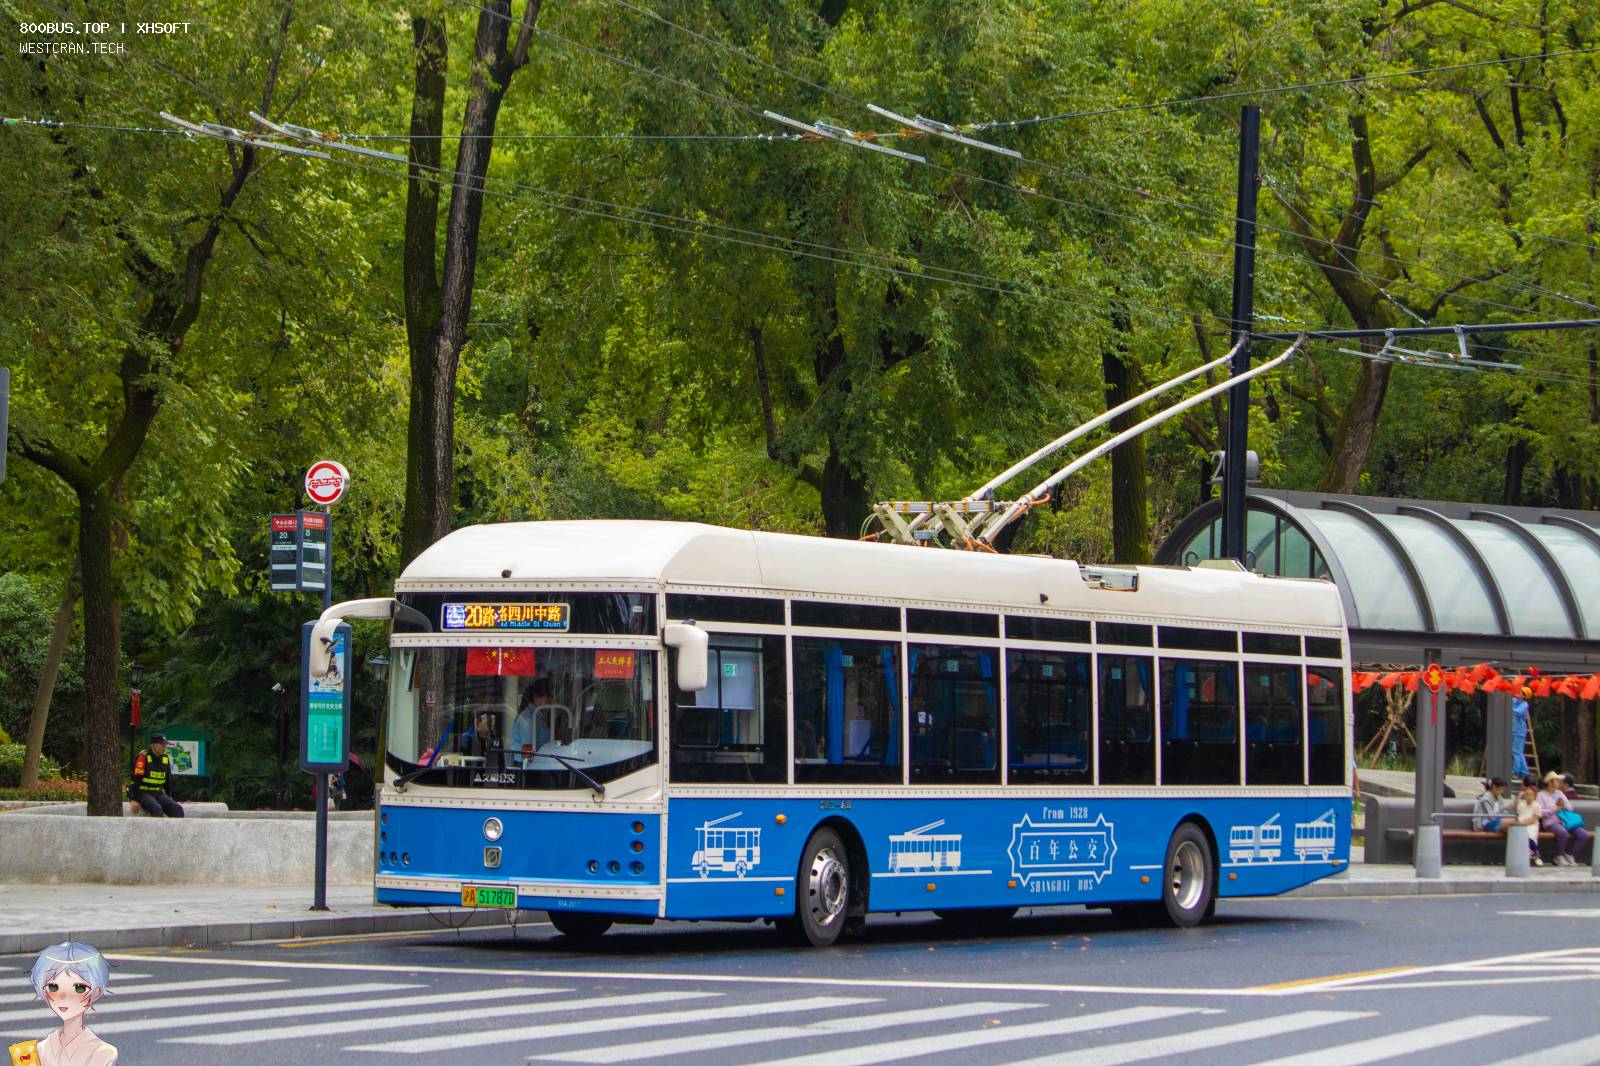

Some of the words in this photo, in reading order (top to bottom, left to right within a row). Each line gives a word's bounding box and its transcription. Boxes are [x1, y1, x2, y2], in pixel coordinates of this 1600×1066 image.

[279, 531, 288, 539] 20
[464, 605, 496, 627] 20路
[1043, 806, 1064, 820] From
[1070, 806, 1088, 819] 1928
[1029, 838, 1098, 861] 百年公交
[1030, 879, 1070, 893] SHANGHAI
[1078, 879, 1094, 892] BUS
